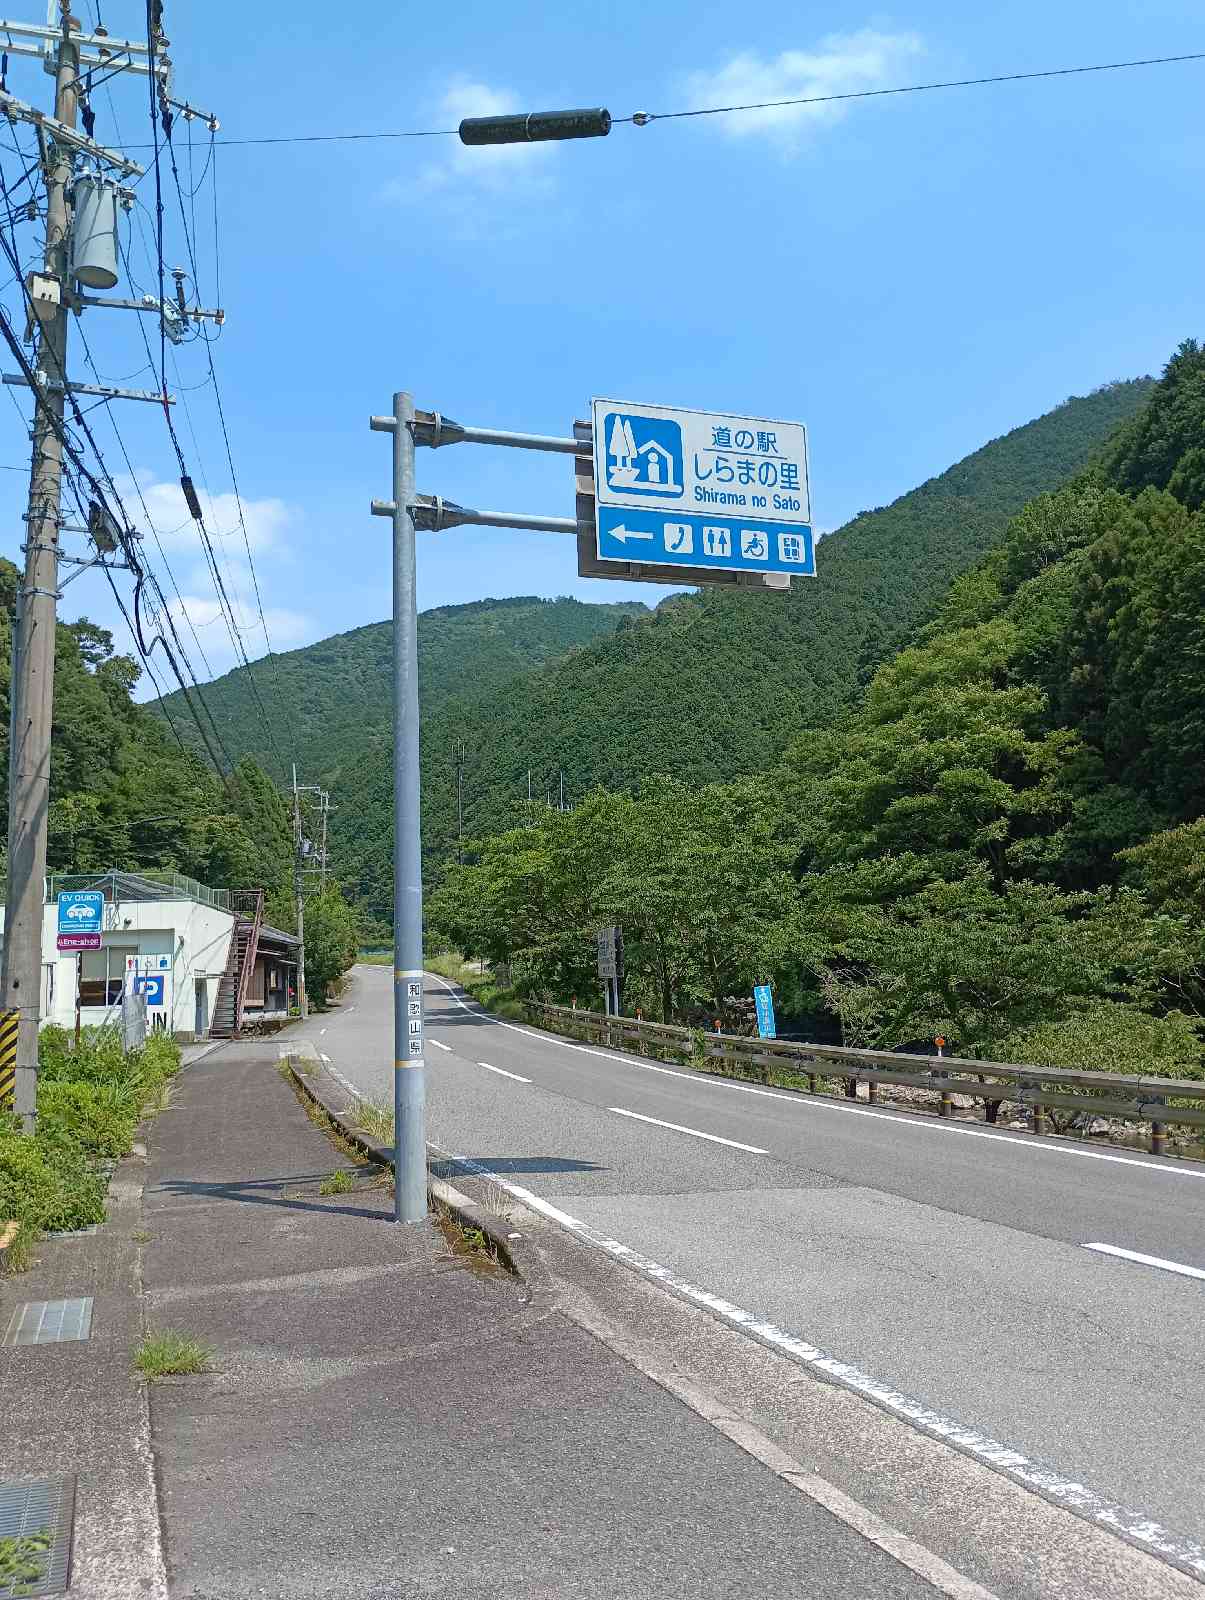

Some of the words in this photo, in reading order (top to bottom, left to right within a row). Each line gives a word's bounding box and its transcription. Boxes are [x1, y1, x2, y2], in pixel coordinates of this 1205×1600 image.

[712, 426, 778, 454] 道の駅
[695, 454, 800, 490] しらまの里
[695, 486, 747, 506] Shirama
[752, 496, 767, 508] no
[773, 494, 801, 512] Sato
[152, 1012, 167, 1032] IN
[409, 984, 421, 1053] 和歌山県
